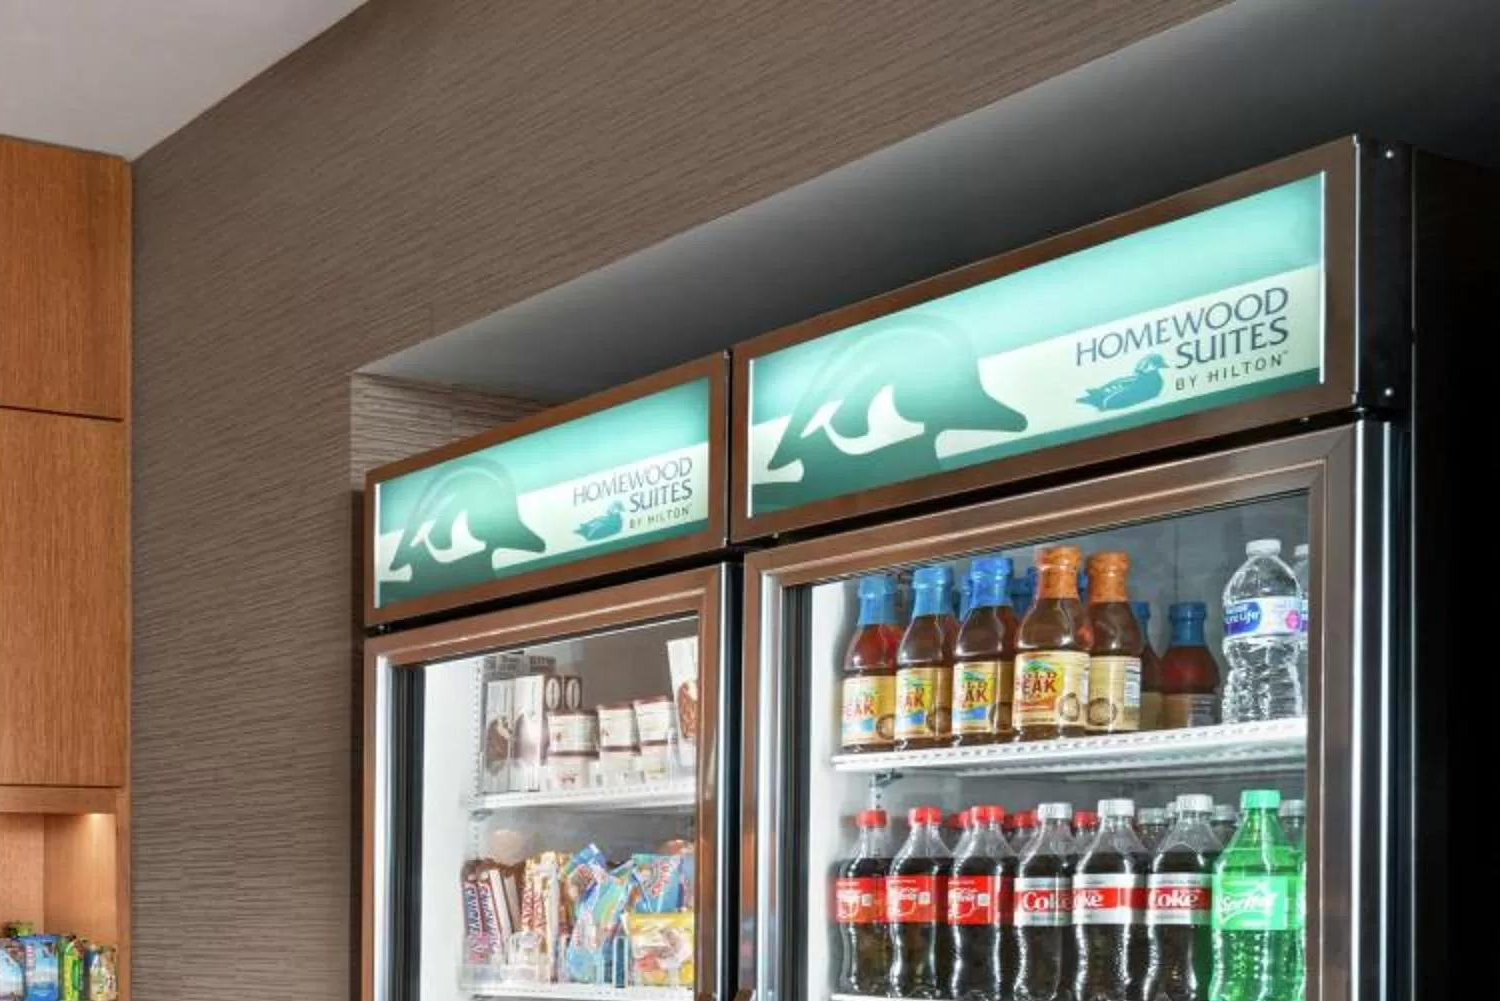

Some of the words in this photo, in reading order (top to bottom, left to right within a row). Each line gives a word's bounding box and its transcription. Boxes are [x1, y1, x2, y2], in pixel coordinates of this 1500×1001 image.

[1075, 287, 1289, 366] HOMEWOOD
[1175, 316, 1289, 369] SUITES
[1175, 376, 1198, 391] BY
[1207, 354, 1282, 383] HILTON
[573, 456, 693, 507] HOMEWOOD
[629, 478, 693, 513] SUITES
